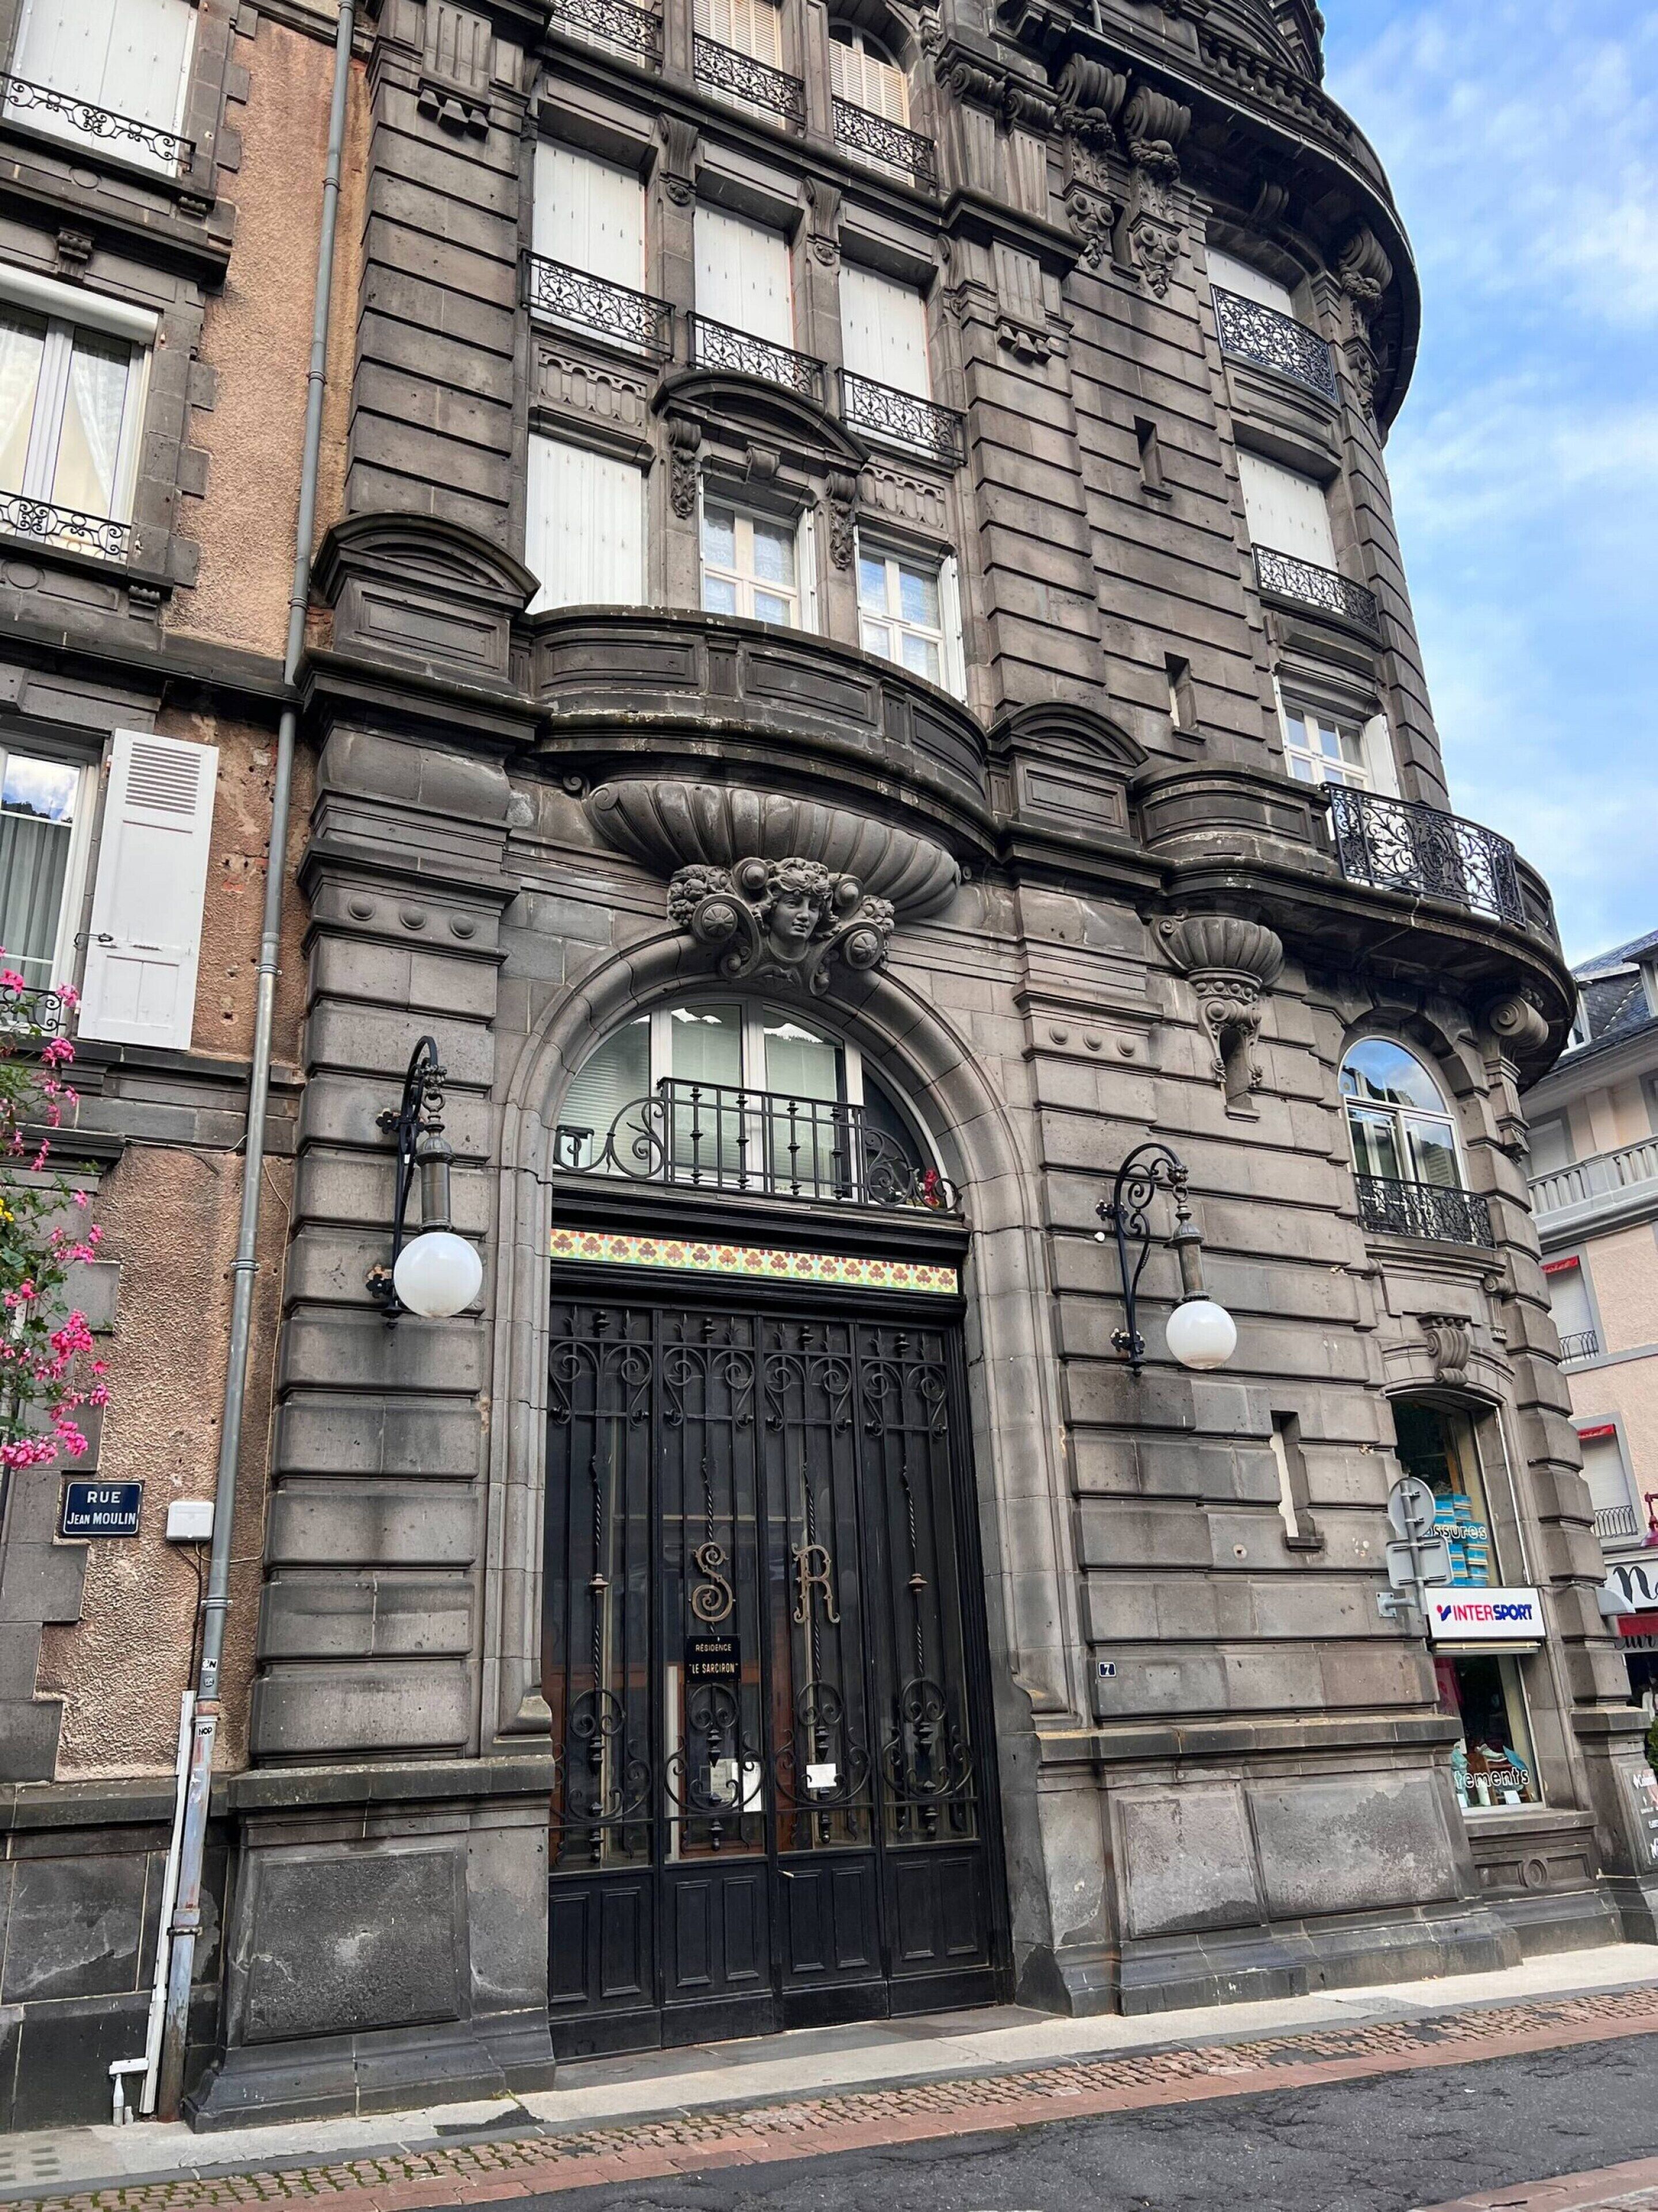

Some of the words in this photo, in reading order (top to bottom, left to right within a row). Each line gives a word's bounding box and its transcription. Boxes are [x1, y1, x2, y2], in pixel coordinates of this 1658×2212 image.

[87, 1491, 121, 1503] RUE
[93, 1512, 136, 1525] MOULIN
[1453, 1604, 1532, 1621] INTERSPORT
[695, 1643, 731, 1652] RÉSIDENCE
[1104, 1664, 1110, 1675] 7
